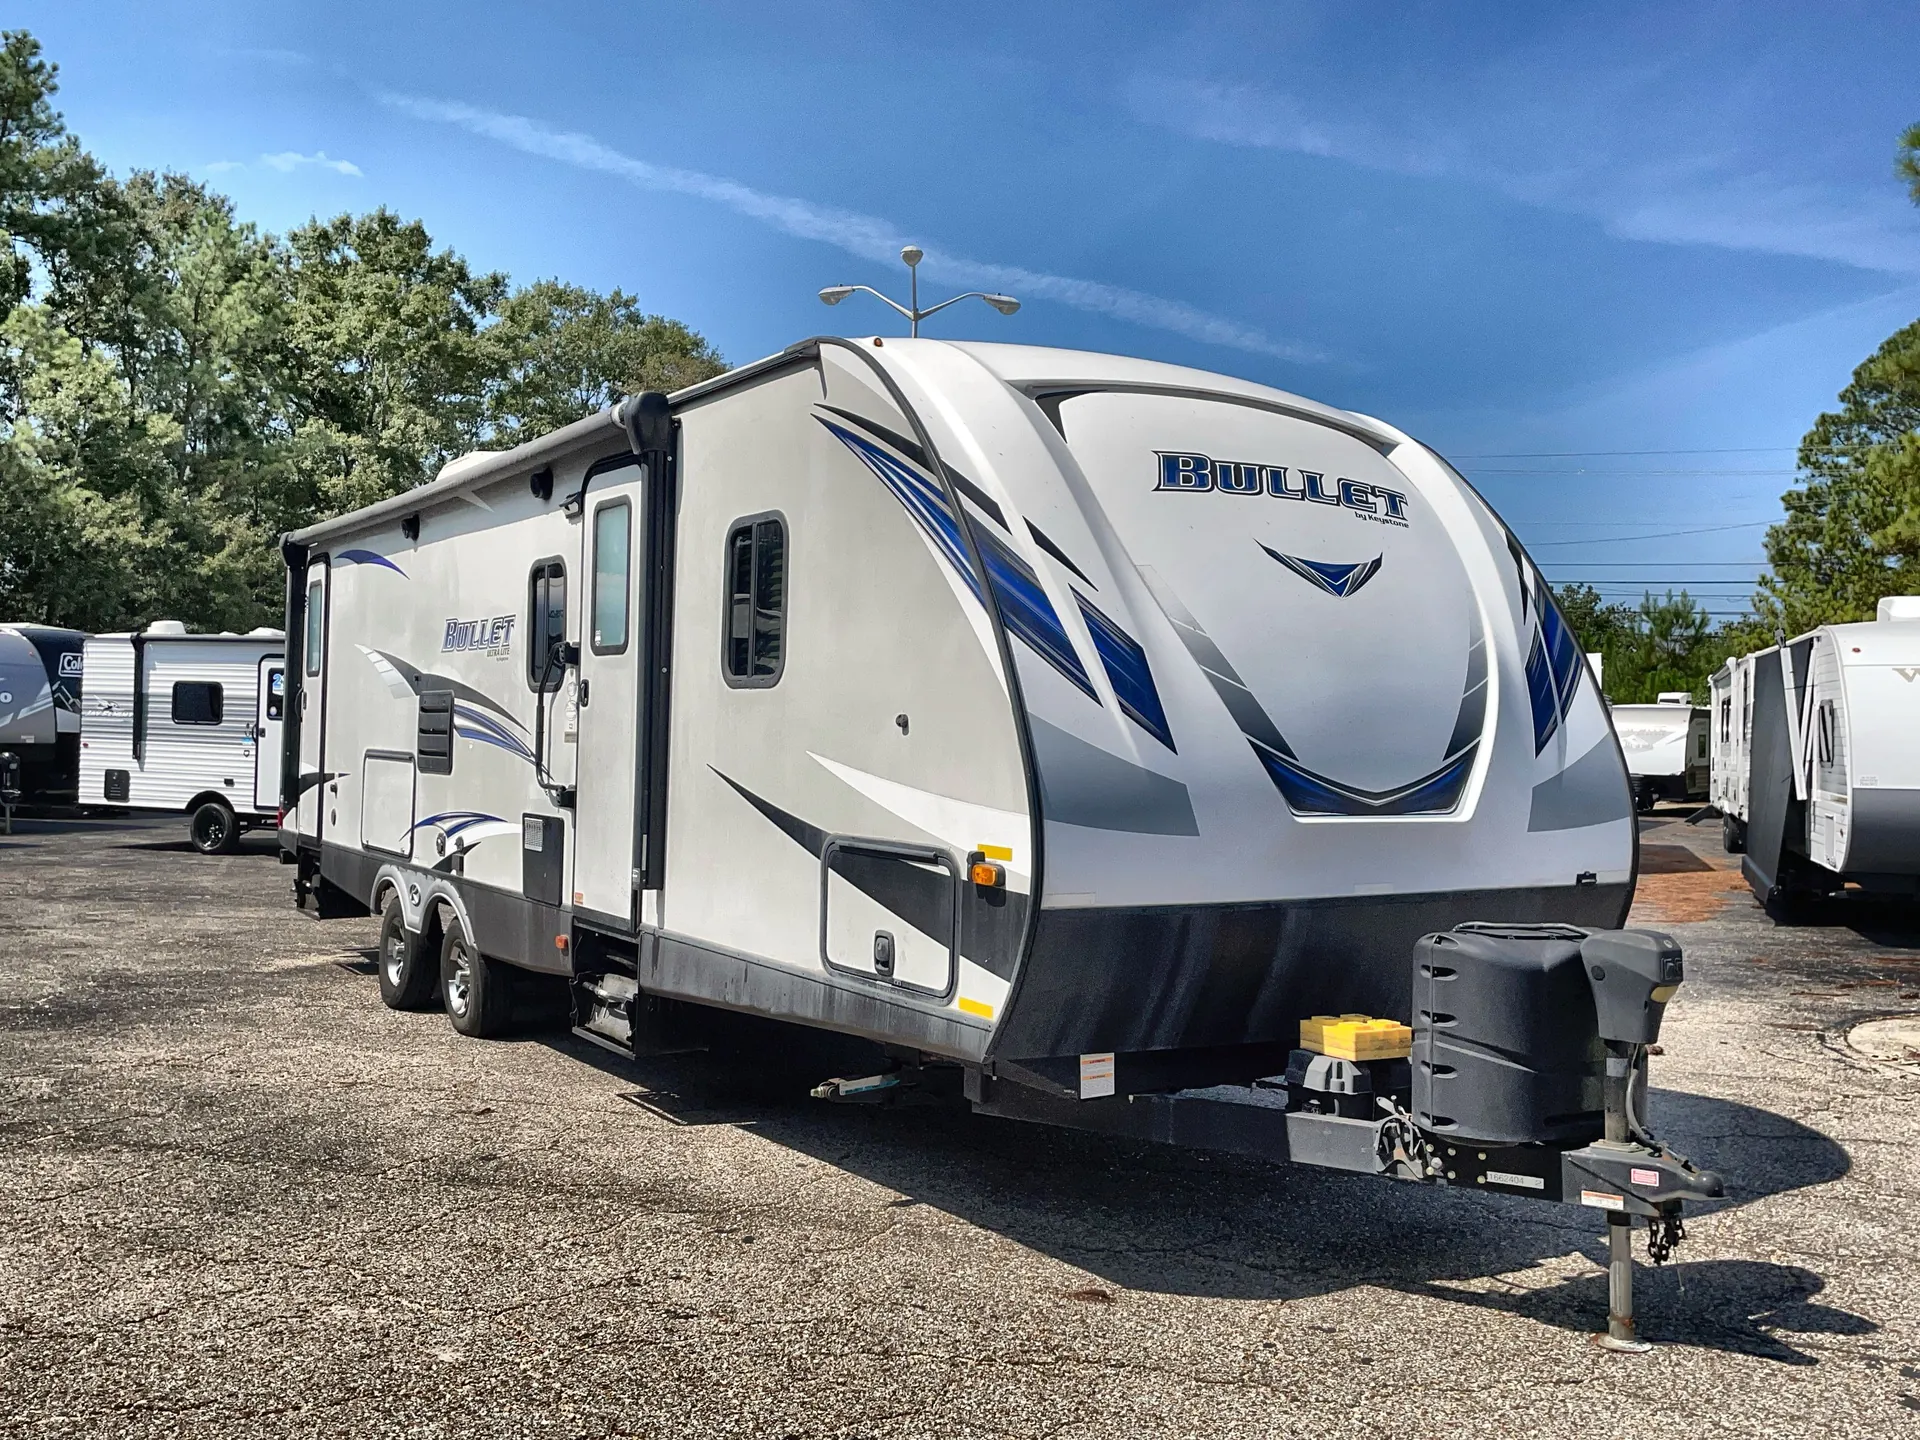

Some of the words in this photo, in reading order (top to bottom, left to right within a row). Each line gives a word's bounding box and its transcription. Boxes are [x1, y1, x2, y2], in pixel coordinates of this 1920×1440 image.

[1151, 450, 1409, 520] BULLET
[1354, 511, 1368, 521] by
[1368, 514, 1409, 529] Keystone
[441, 614, 516, 653] BULLET
